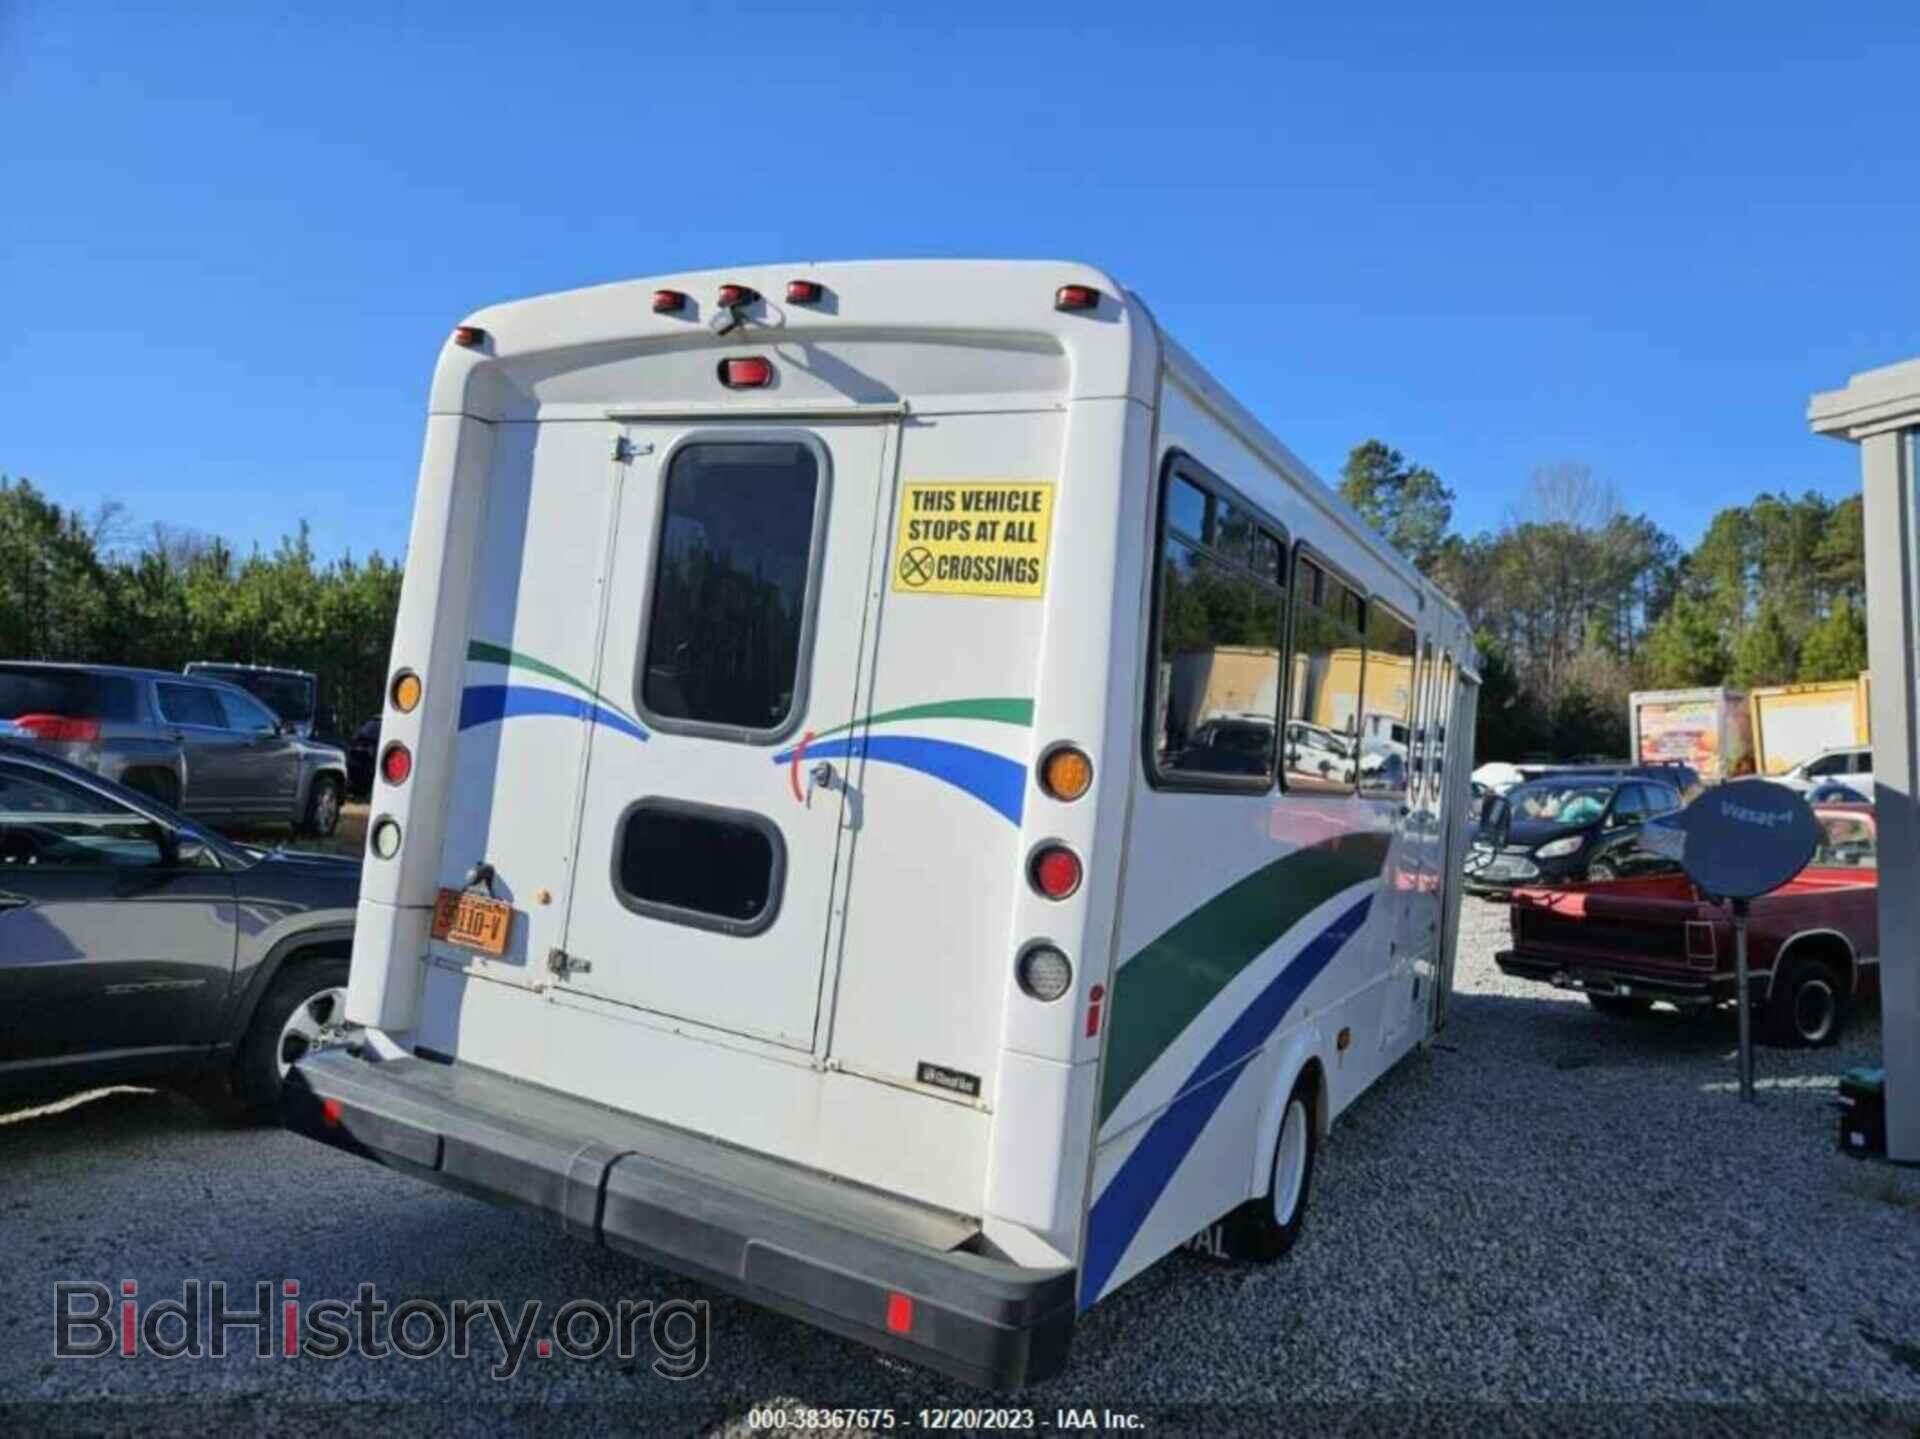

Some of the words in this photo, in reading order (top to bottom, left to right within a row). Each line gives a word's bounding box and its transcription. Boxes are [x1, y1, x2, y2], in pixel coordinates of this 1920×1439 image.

[912, 490, 956, 512] THIS
[961, 490, 1043, 512] VEHICLE
[908, 519, 972, 541] STOPS
[975, 520, 1000, 542] AT
[1003, 520, 1037, 543] ALL
[936, 555, 1040, 585] CROSSINGS
